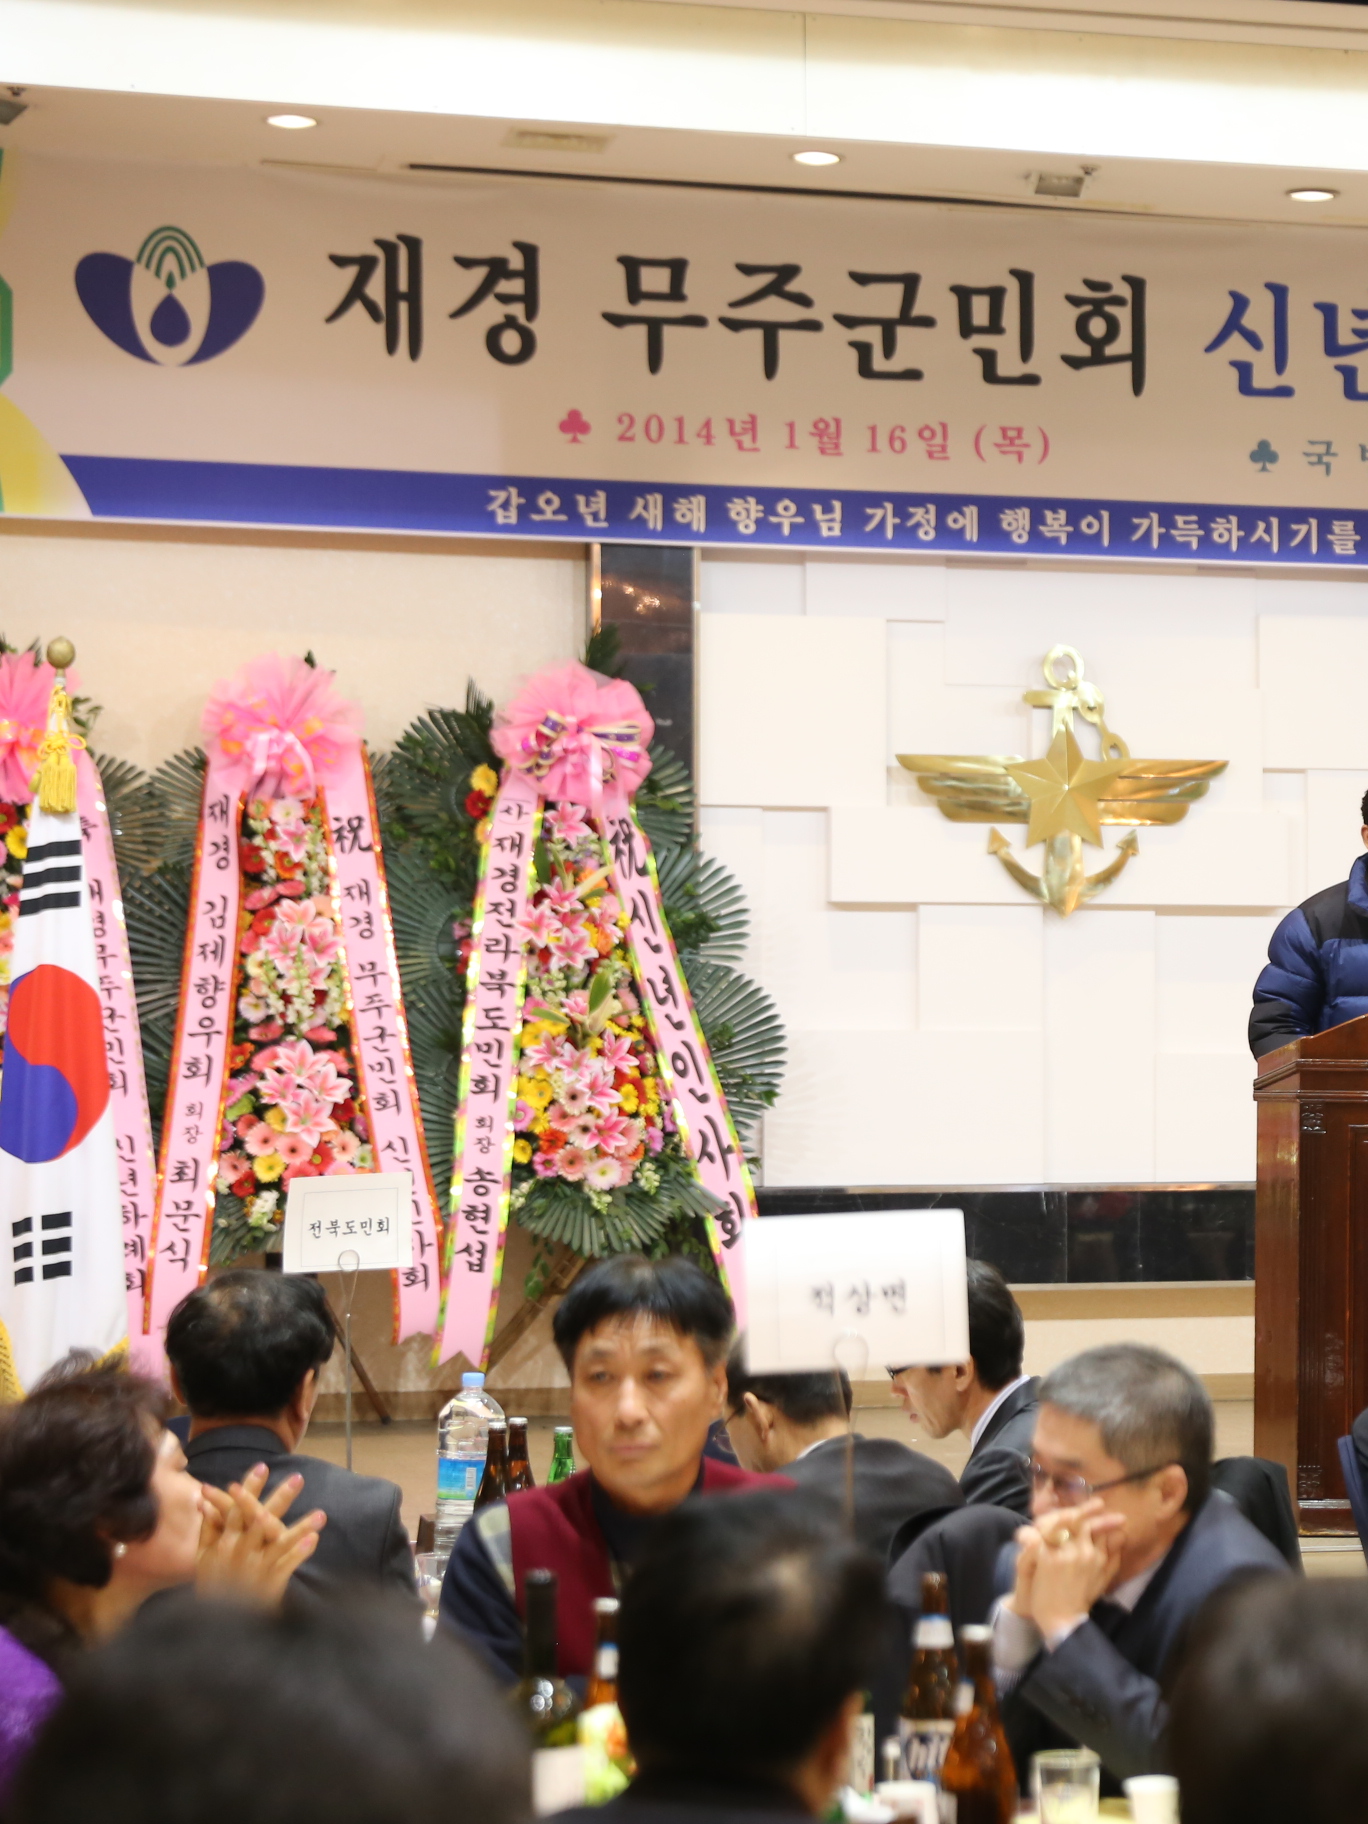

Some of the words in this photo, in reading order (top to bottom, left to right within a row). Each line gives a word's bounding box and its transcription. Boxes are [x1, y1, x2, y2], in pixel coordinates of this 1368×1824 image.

[324, 233, 543, 366] 재경
[600, 253, 1148, 397] 무주군민회
[617, 412, 762, 452] 2014년
[782, 415, 844, 457] 1월
[863, 421, 950, 461] 16일
[973, 421, 1050, 466] (목)
[487, 487, 608, 528] 갑오년
[629, 491, 707, 534] 새해
[728, 495, 842, 539] 향우님
[863, 500, 979, 543] 가정에
[999, 507, 1112, 549] 행복이
[1131, 511, 1361, 557] 가득하시기를
[207, 794, 230, 871] 재경
[332, 816, 373, 854] 祝
[343, 878, 375, 941] 재경
[182, 895, 230, 1088] 김제향우회
[353, 961, 401, 1117] 무주군민회
[609, 818, 648, 879] 祝
[631, 890, 745, 1249] 신년인사회
[181, 1102, 204, 1145] 회장
[473, 1115, 494, 1155] 회장
[308, 1216, 389, 1239] 전북도민회
[455, 1167, 501, 1274] 송현섭
